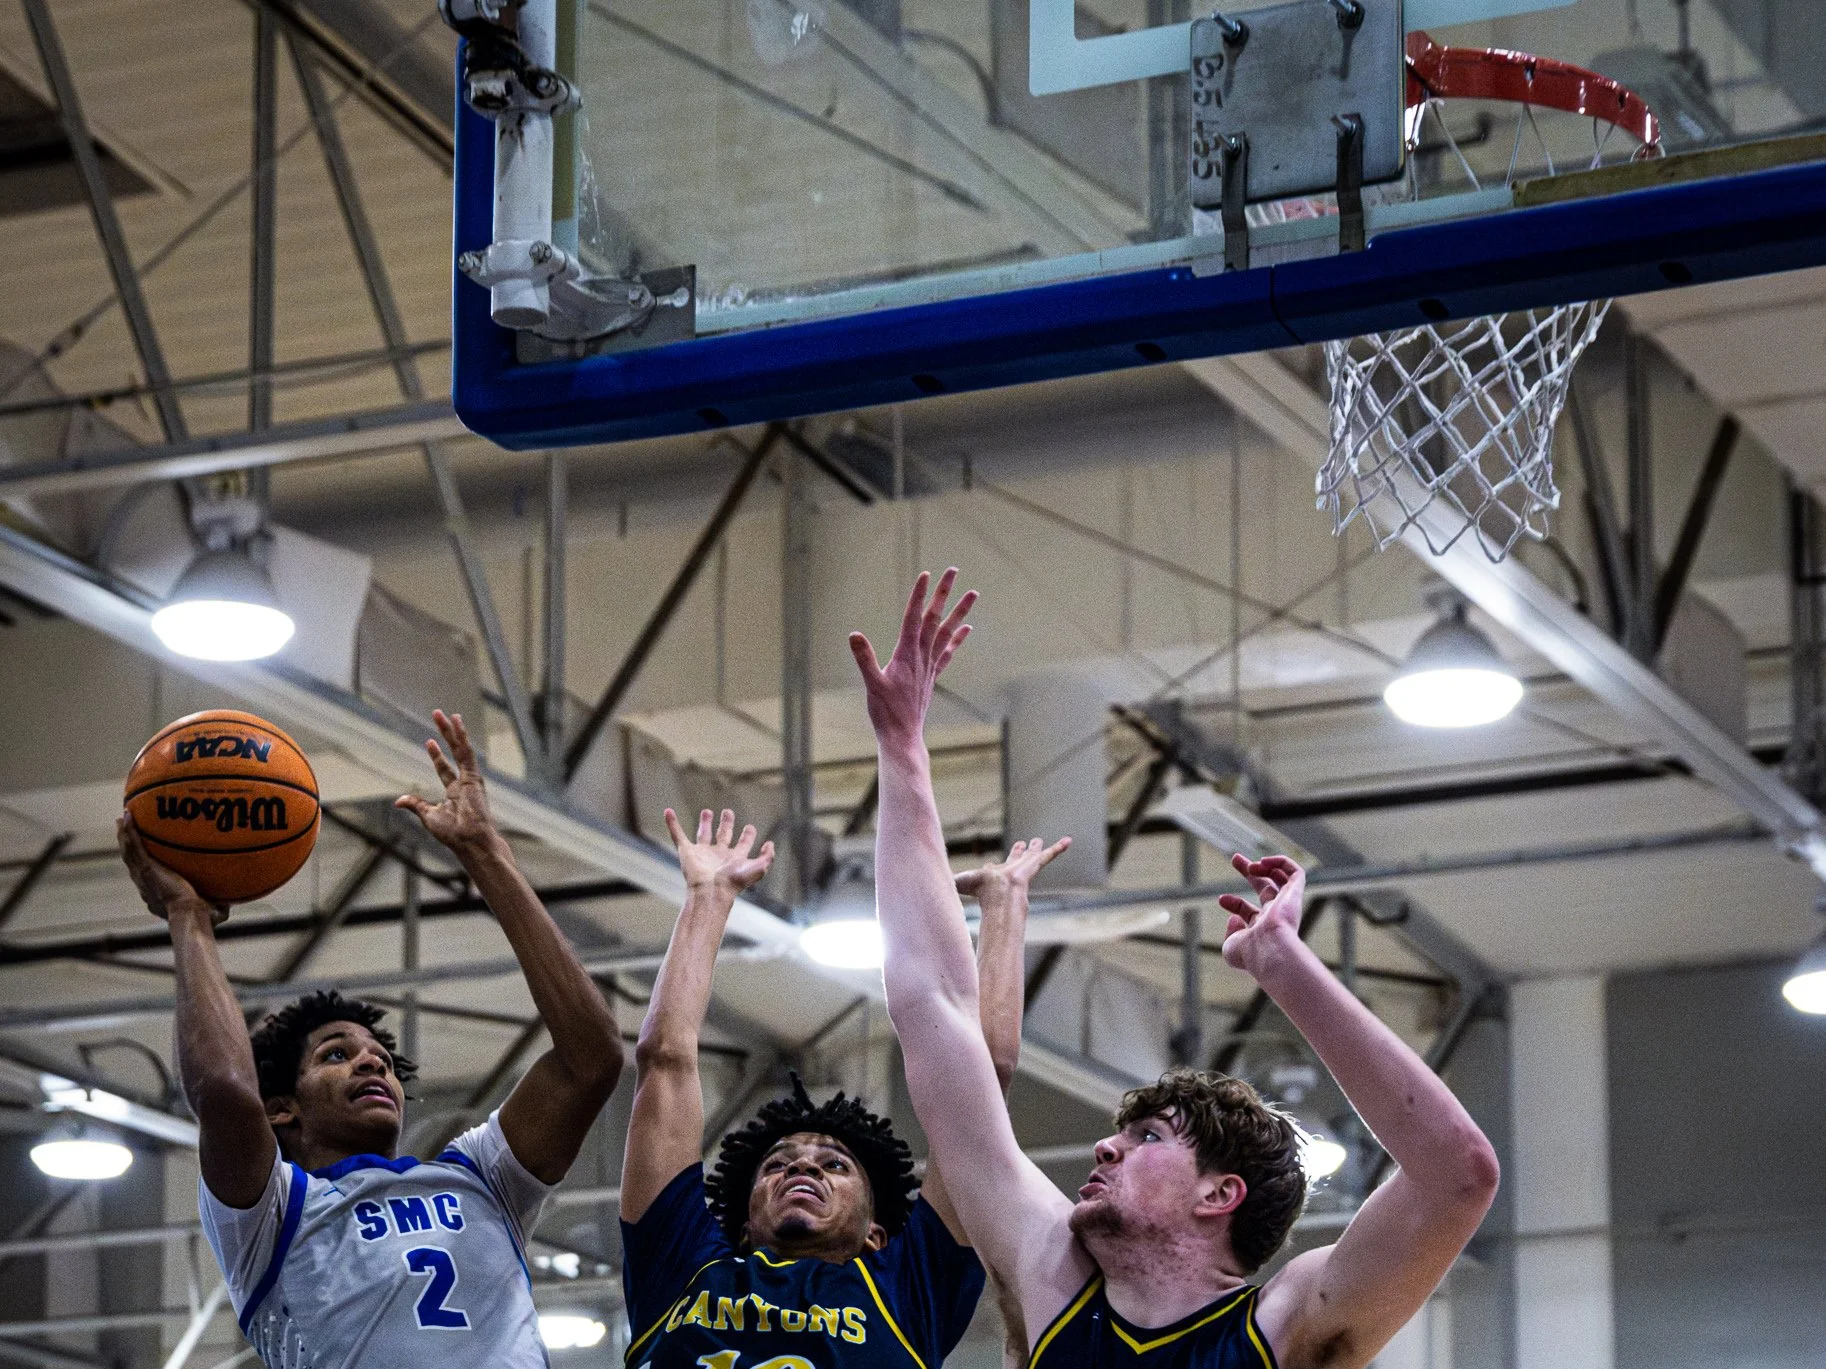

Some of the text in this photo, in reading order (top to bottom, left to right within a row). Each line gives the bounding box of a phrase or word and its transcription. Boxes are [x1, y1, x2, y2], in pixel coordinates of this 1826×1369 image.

[176, 735, 272, 764] NCAA
[156, 795, 289, 833] Wilson
[352, 1191, 467, 1244] SMC
[401, 1244, 472, 1331] 2
[665, 1290, 867, 1345] CANYONS
